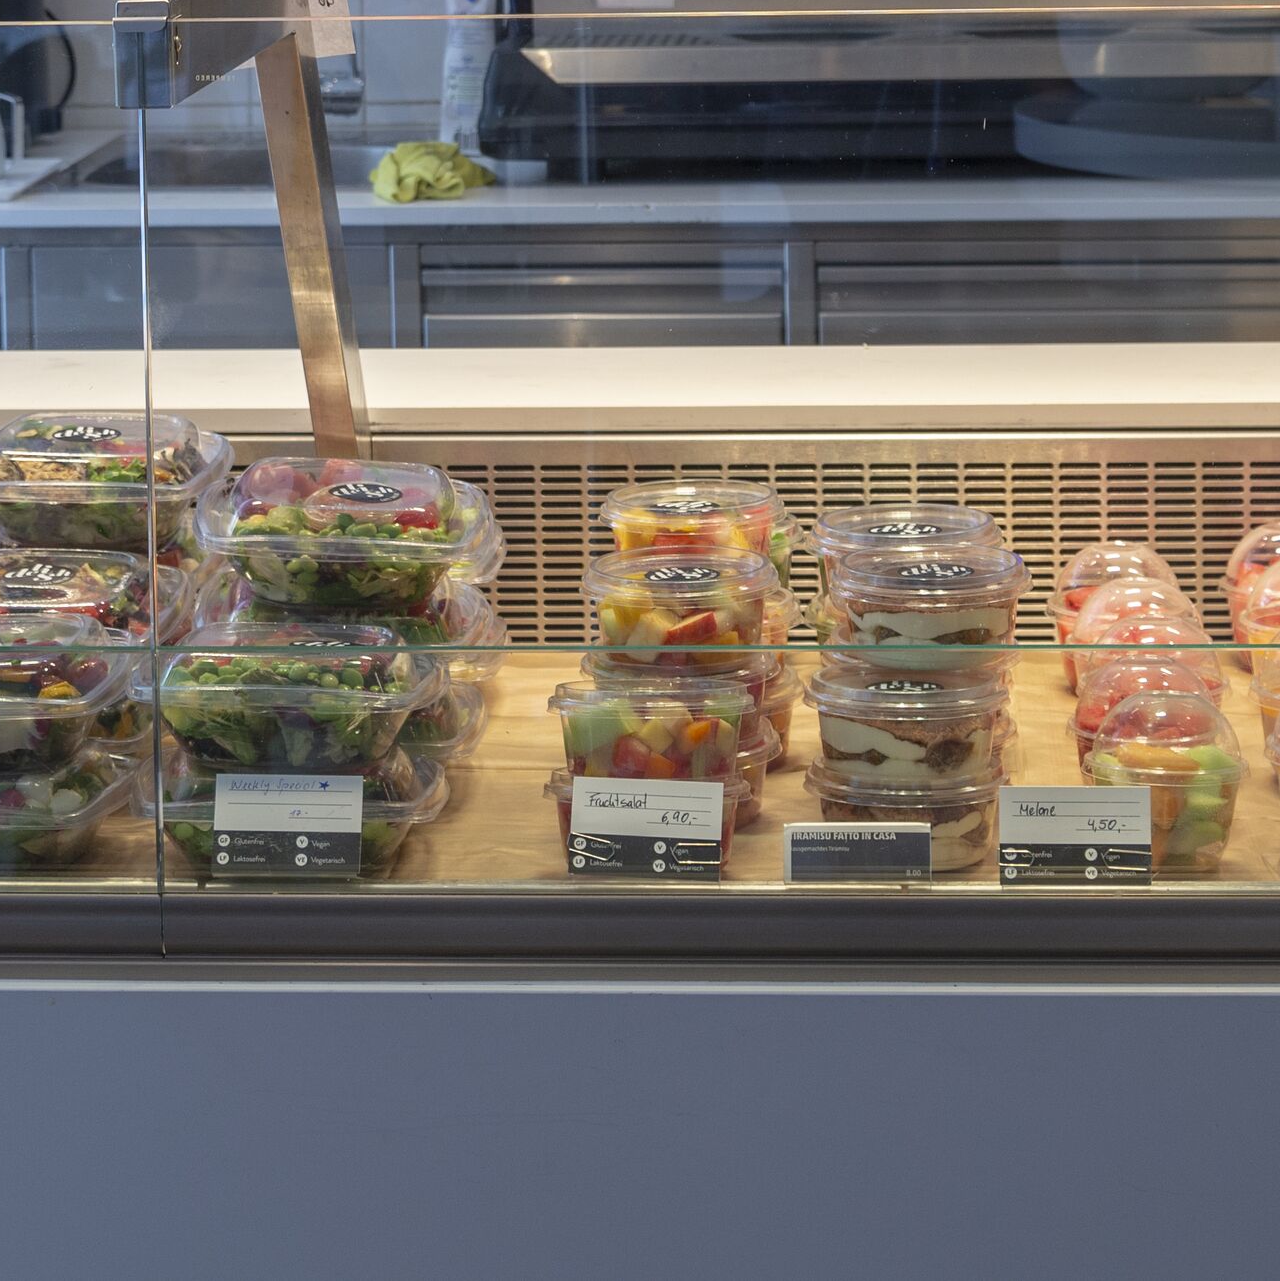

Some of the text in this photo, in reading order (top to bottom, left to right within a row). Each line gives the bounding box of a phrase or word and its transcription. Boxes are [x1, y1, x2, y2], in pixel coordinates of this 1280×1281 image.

[1020, 802, 1056, 816] Melone
[862, 832, 896, 840] IN CASA
